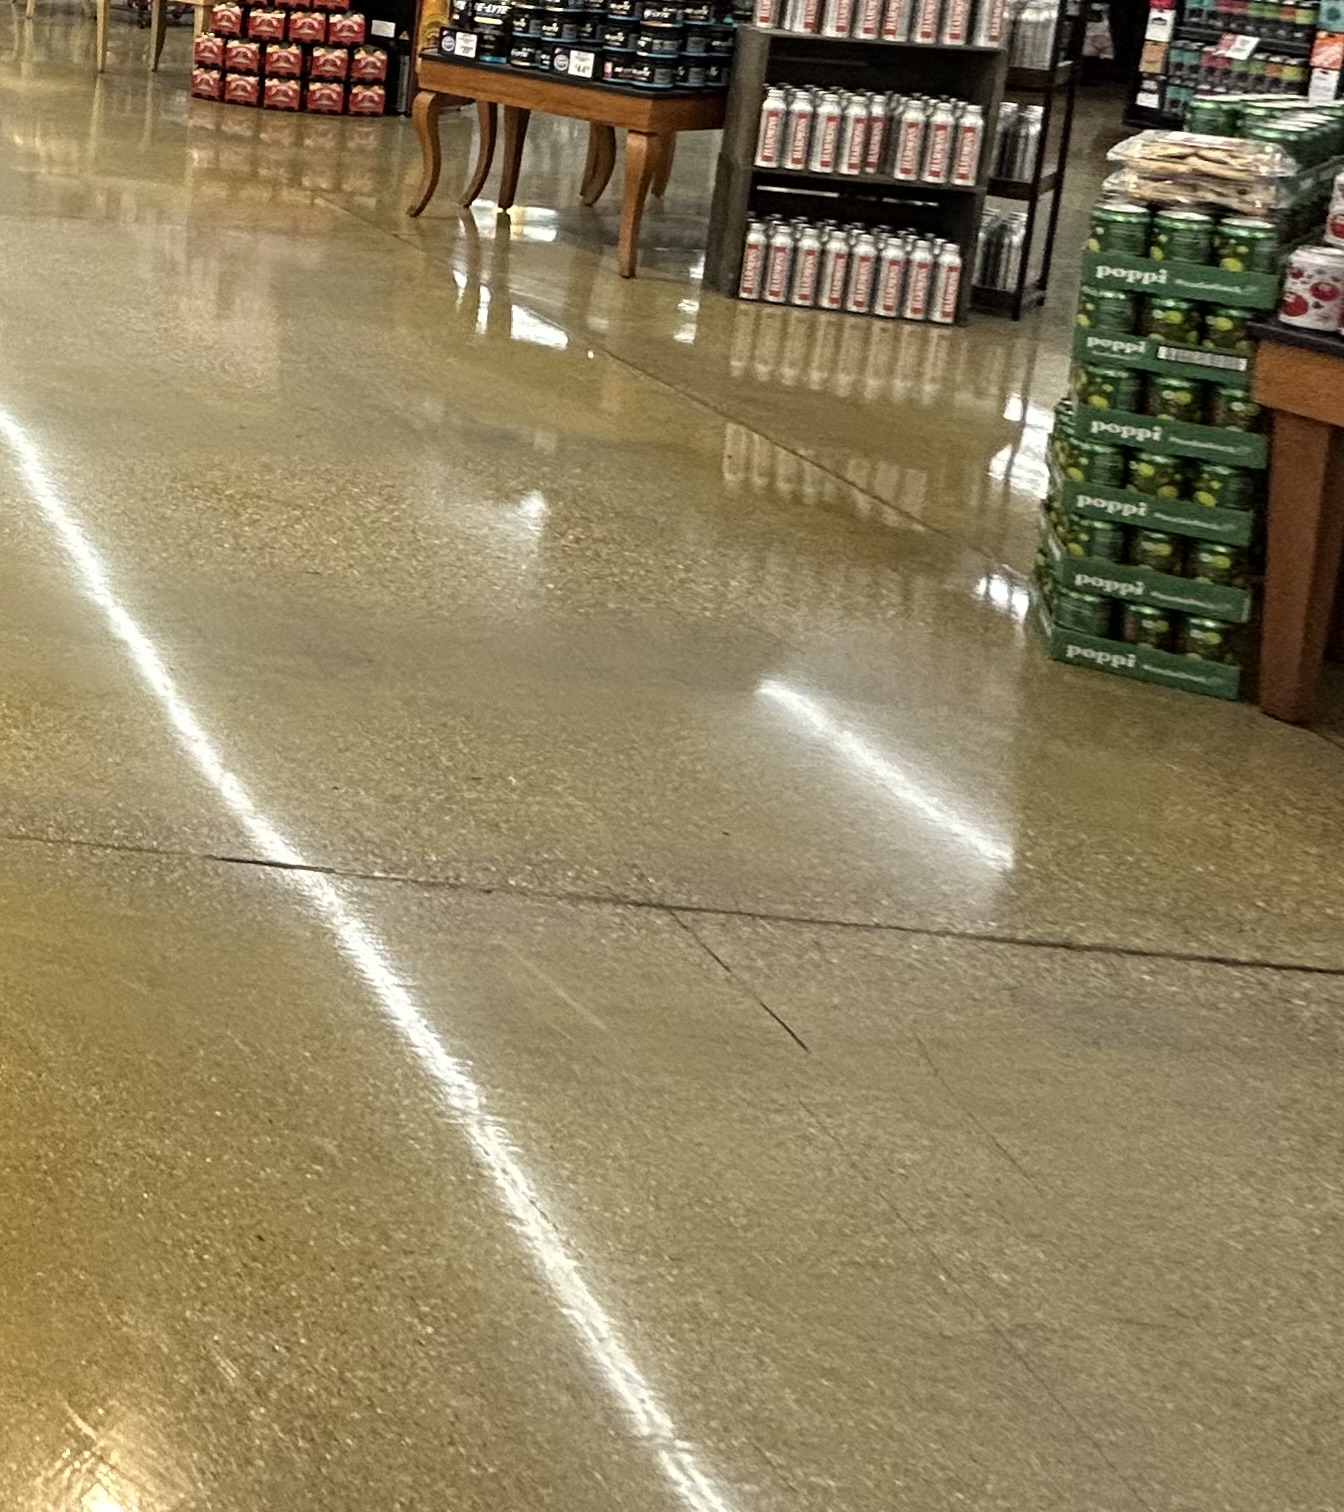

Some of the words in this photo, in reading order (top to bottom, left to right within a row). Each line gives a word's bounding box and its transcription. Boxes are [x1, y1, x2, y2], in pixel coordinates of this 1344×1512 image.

[1096, 265, 1167, 284] poppi
[1086, 337, 1147, 354] poppi
[1091, 420, 1161, 441] poppi
[1077, 494, 1148, 516] poppi
[1075, 574, 1145, 595] poppi
[1066, 645, 1136, 668] poppi
